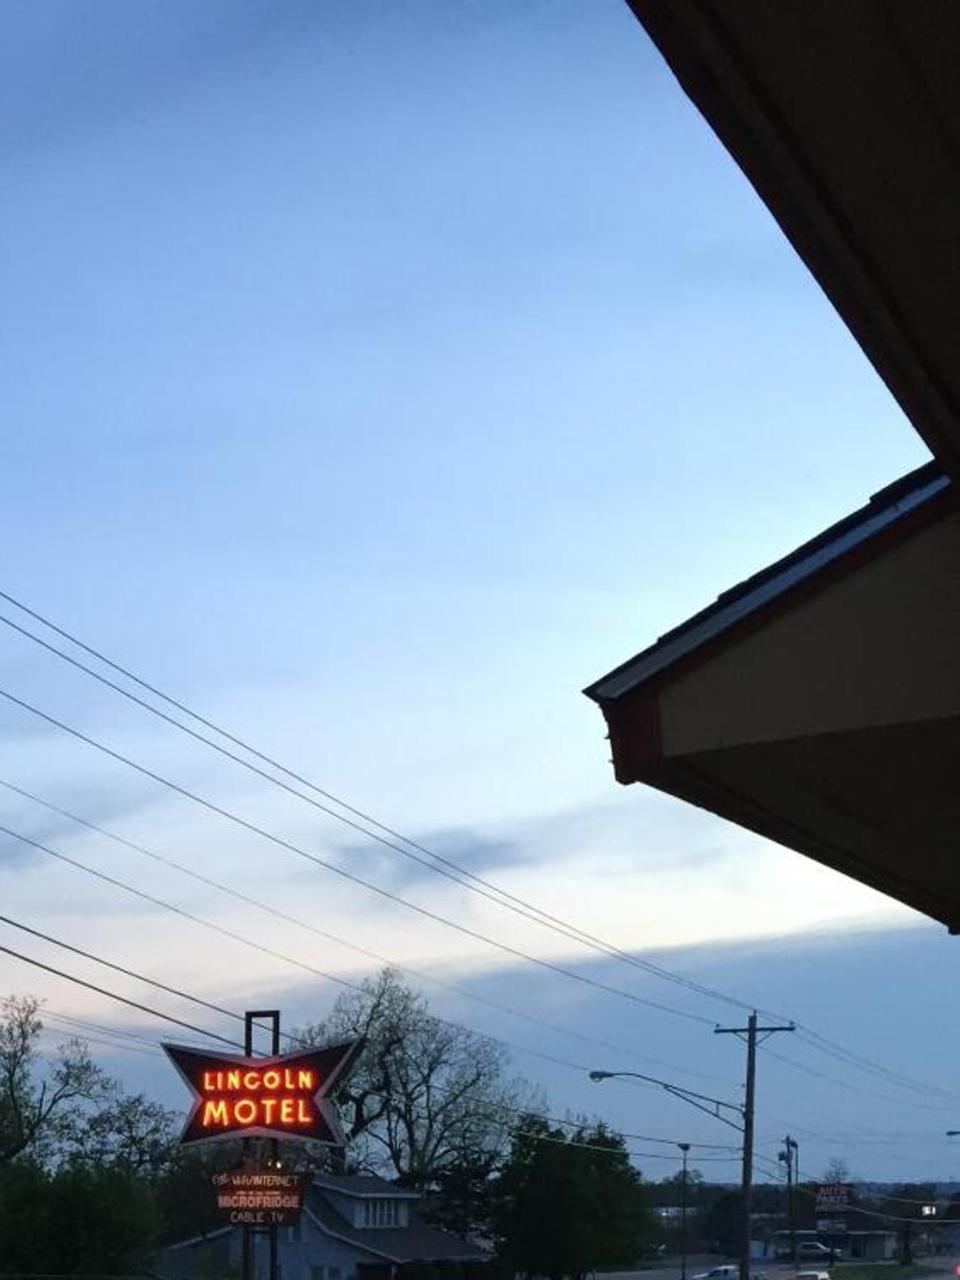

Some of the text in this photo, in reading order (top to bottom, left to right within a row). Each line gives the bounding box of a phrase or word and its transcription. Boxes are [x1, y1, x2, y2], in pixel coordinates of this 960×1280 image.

[203, 1068, 314, 1091] LINCOLN
[202, 1099, 314, 1127] MOTEL
[217, 1195, 300, 1208] MICROFRIDGE
[230, 1210, 285, 1223] CABLE TV
